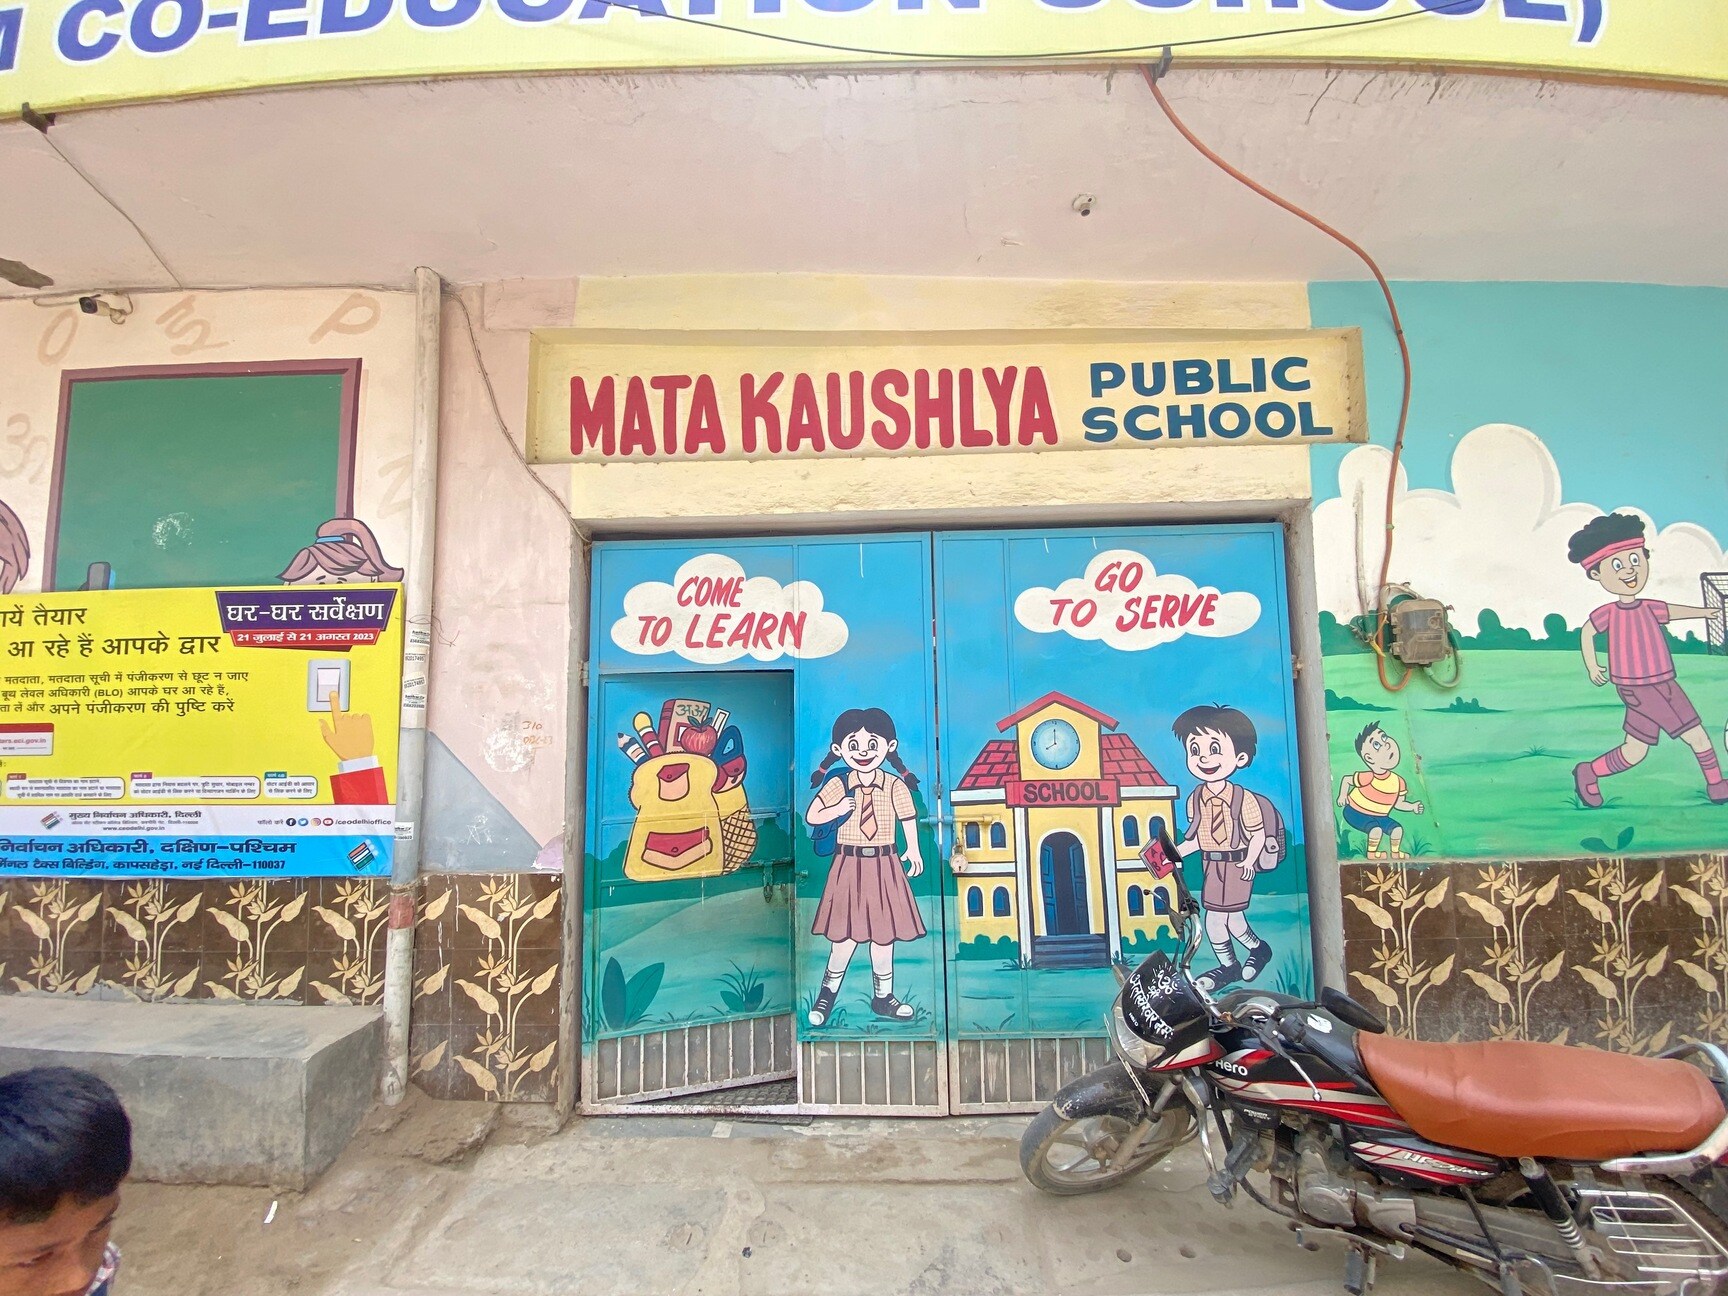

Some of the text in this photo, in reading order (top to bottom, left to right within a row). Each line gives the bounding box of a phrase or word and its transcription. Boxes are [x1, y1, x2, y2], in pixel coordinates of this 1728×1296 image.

[1090, 356, 1311, 398] PUBLIC
[570, 366, 1059, 456] MATA KAUSHLYA
[1081, 401, 1333, 443] SCHOOL
[1094, 561, 1143, 593] GO
[677, 576, 745, 608] COME
[0, 603, 88, 627] ायें तैयार
[226, 597, 384, 622] घर-घर सर्वेक्षण
[1050, 594, 1218, 632] TO SERVE
[237, 631, 374, 644] 21 जुलाई से 21 अगस्त 2023
[638, 611, 807, 650] TO LEARN
[8, 631, 221, 658] आ रहे हैं आपके द्वार
[4, 670, 249, 685] मतदाता, मतदाता सूची में पंजीकरण से छूट न जाए
[1, 690, 17, 701] बूथ
[20, 688, 45, 698] लेवल
[48, 686, 91, 698] अधिकारी
[94, 689, 123, 698] (BLO)
[127, 685, 159, 696] आपके
[162, 687, 179, 696] घर
[182, 687, 196, 695] आ
[200, 684, 214, 696] रहे
[14, 701, 23, 713] लें
[26, 702, 45, 712] और
[49, 700, 81, 714] अपने
[86, 699, 147, 714] पंजीकरण
[151, 698, 171, 713] की
[175, 698, 207, 717] पुष्टि
[211, 697, 236, 712] करें
[522, 720, 543, 730] 310
[1023, 781, 1109, 803] SCHOOL
[69, 811, 91, 820] मुख्य
[129, 811, 171, 819] अधिकारी,
[67, 839, 154, 854] अधिकारी,
[161, 838, 297, 854] दक्षिण-पश्चिम
[33, 858, 60, 869] टैक्स
[62, 858, 109, 870] बिल्डिंग,
[182, 858, 204, 870] नई
[206, 858, 285, 870] दिल्ली-110037
[1215, 1059, 1248, 1076] Hero
